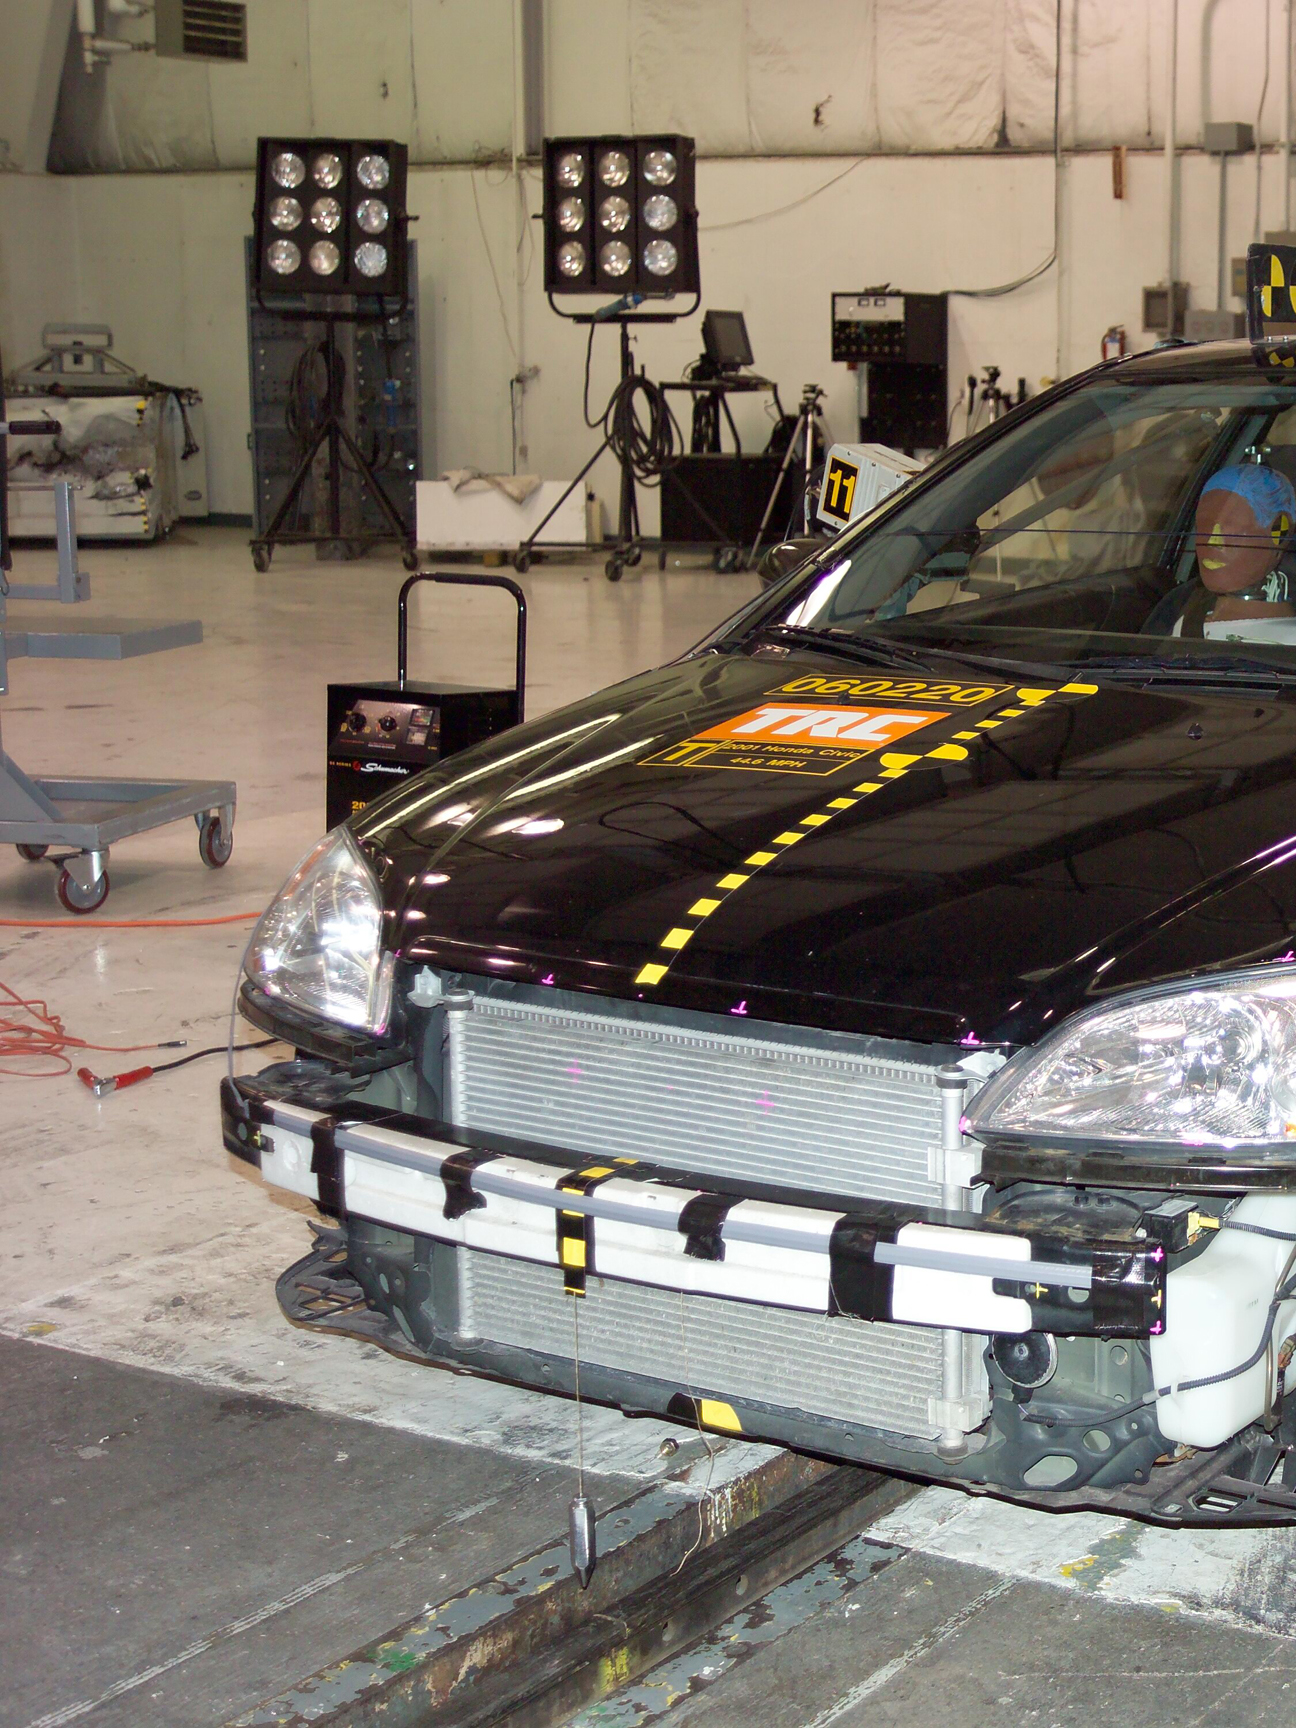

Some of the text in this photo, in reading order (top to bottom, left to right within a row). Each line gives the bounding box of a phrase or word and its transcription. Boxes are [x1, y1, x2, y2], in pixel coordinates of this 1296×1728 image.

[829, 469, 856, 514] 11
[782, 678, 996, 702] 060220
[732, 708, 928, 741] TRC
[664, 743, 716, 760] T
[762, 745, 814, 755] Honda
[819, 747, 861, 759] Civic
[767, 759, 808, 769] MPH
[352, 801, 369, 810] 20
